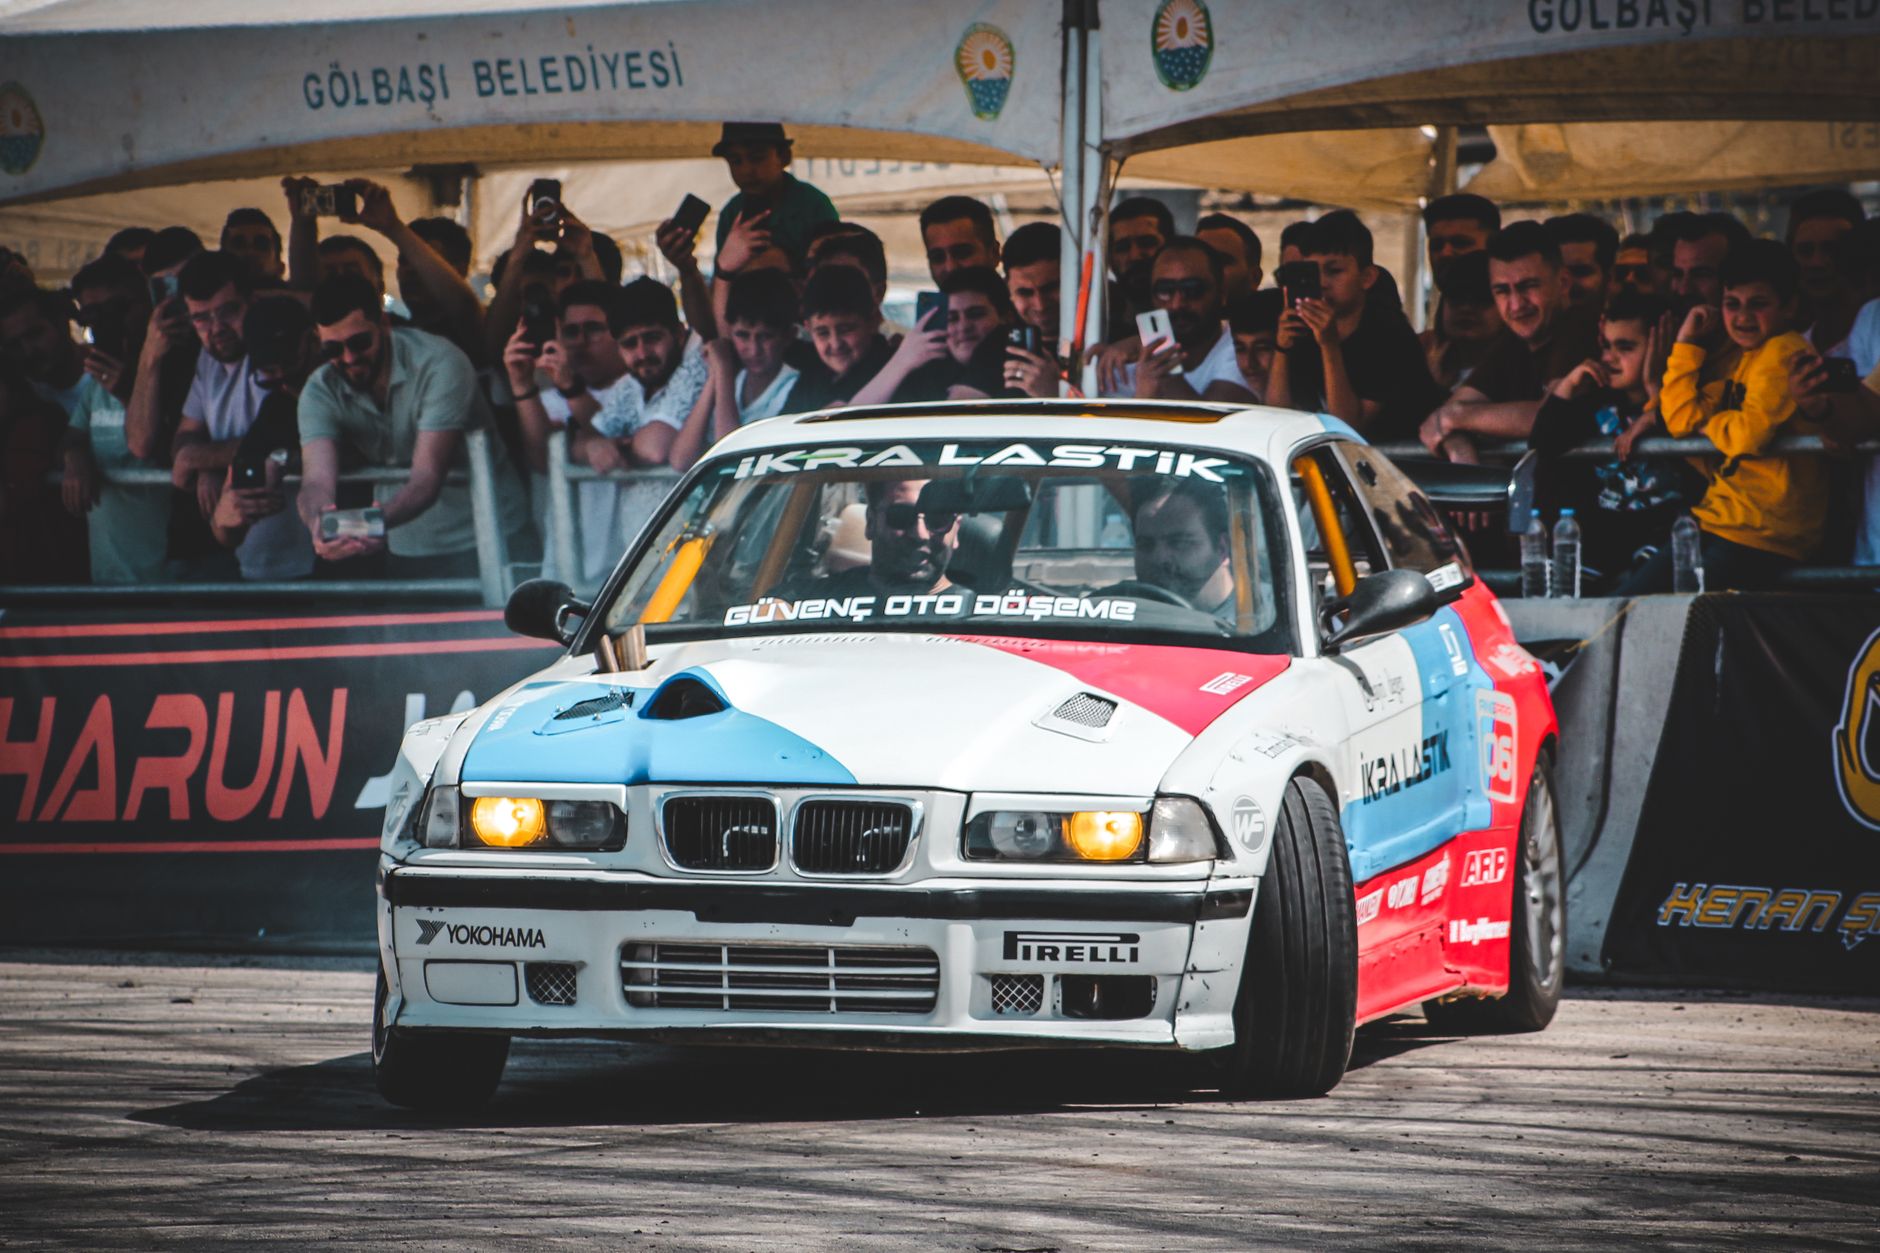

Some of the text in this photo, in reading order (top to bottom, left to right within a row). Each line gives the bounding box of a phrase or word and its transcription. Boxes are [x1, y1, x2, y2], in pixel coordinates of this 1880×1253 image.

[302, 40, 684, 112] GÖLBAŞI BELEDİYESİ
[884, 594, 963, 616] OTO
[0, 687, 348, 823] HARUN
[1483, 731, 1513, 782] 06
[446, 923, 546, 949] YOKOHAMA
[1002, 930, 1141, 963] PIRELLI
